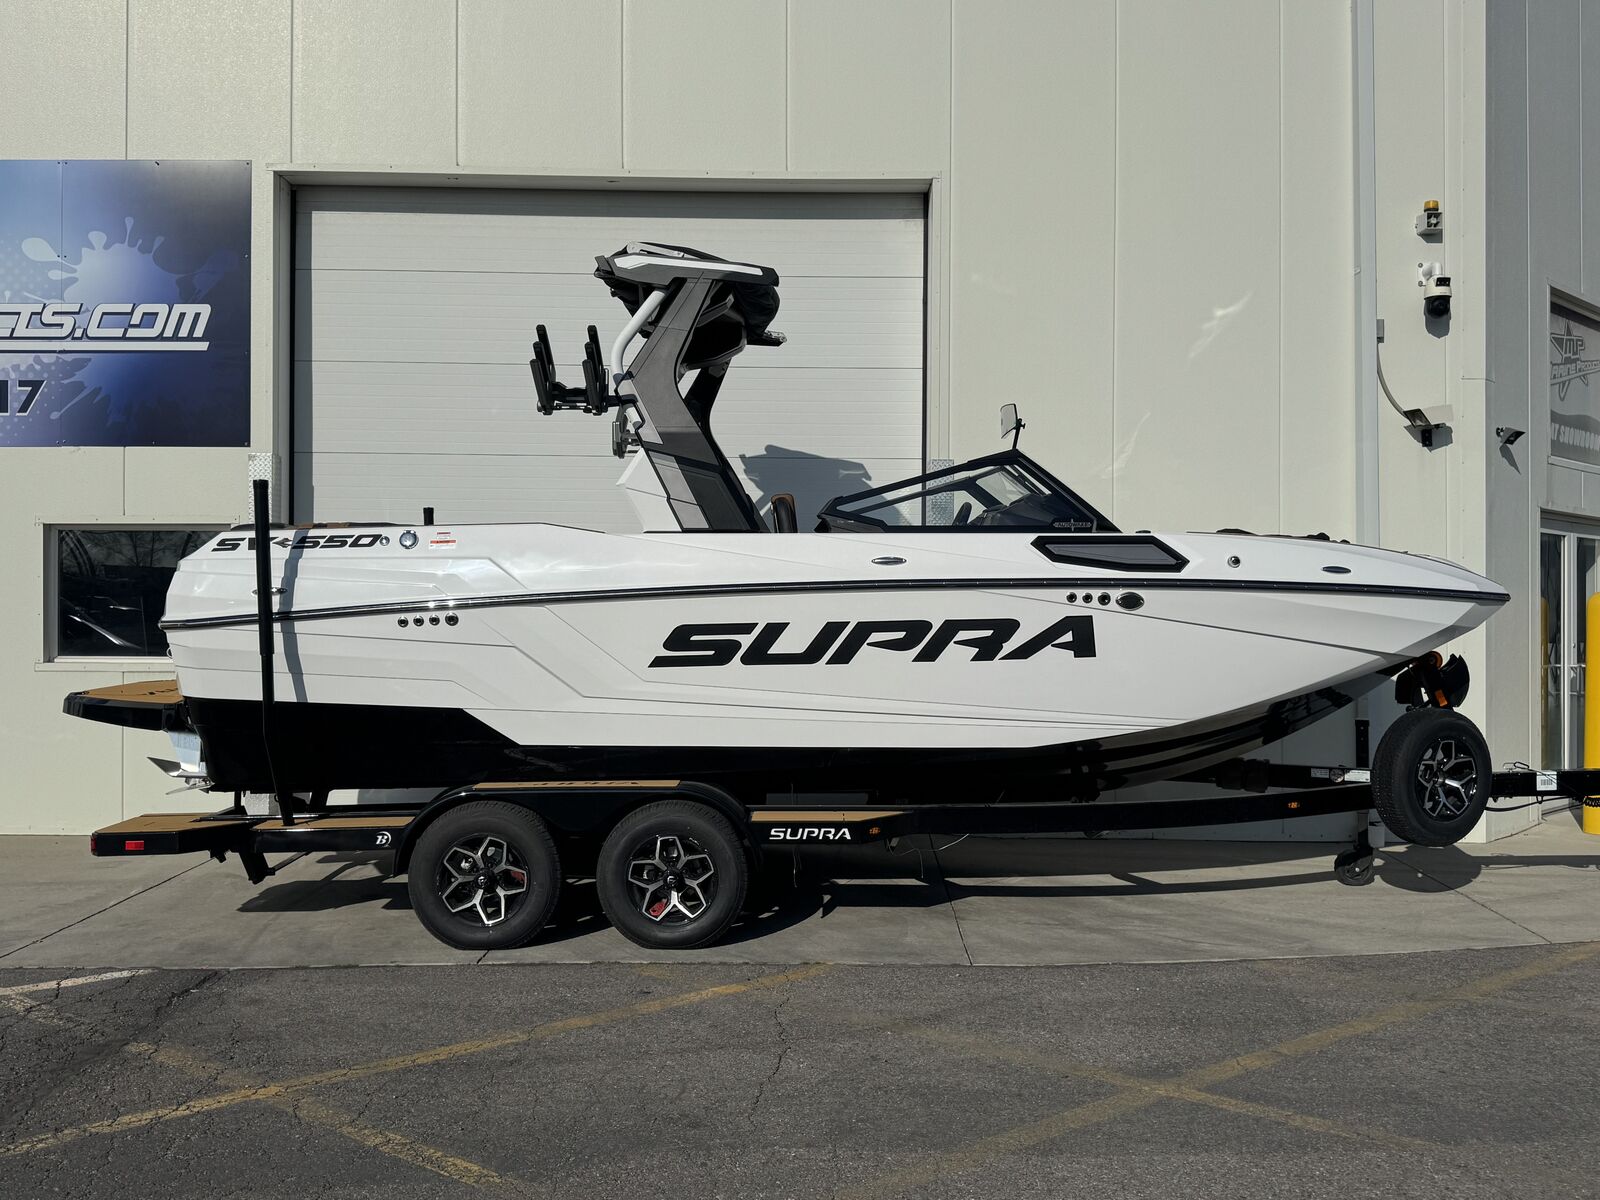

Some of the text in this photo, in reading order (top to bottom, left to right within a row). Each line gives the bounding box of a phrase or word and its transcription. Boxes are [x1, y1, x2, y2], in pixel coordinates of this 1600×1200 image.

[1551, 362, 1577, 380] ARINE
[648, 615, 1096, 668] SUPRA
[769, 828, 852, 840] SUPRA
